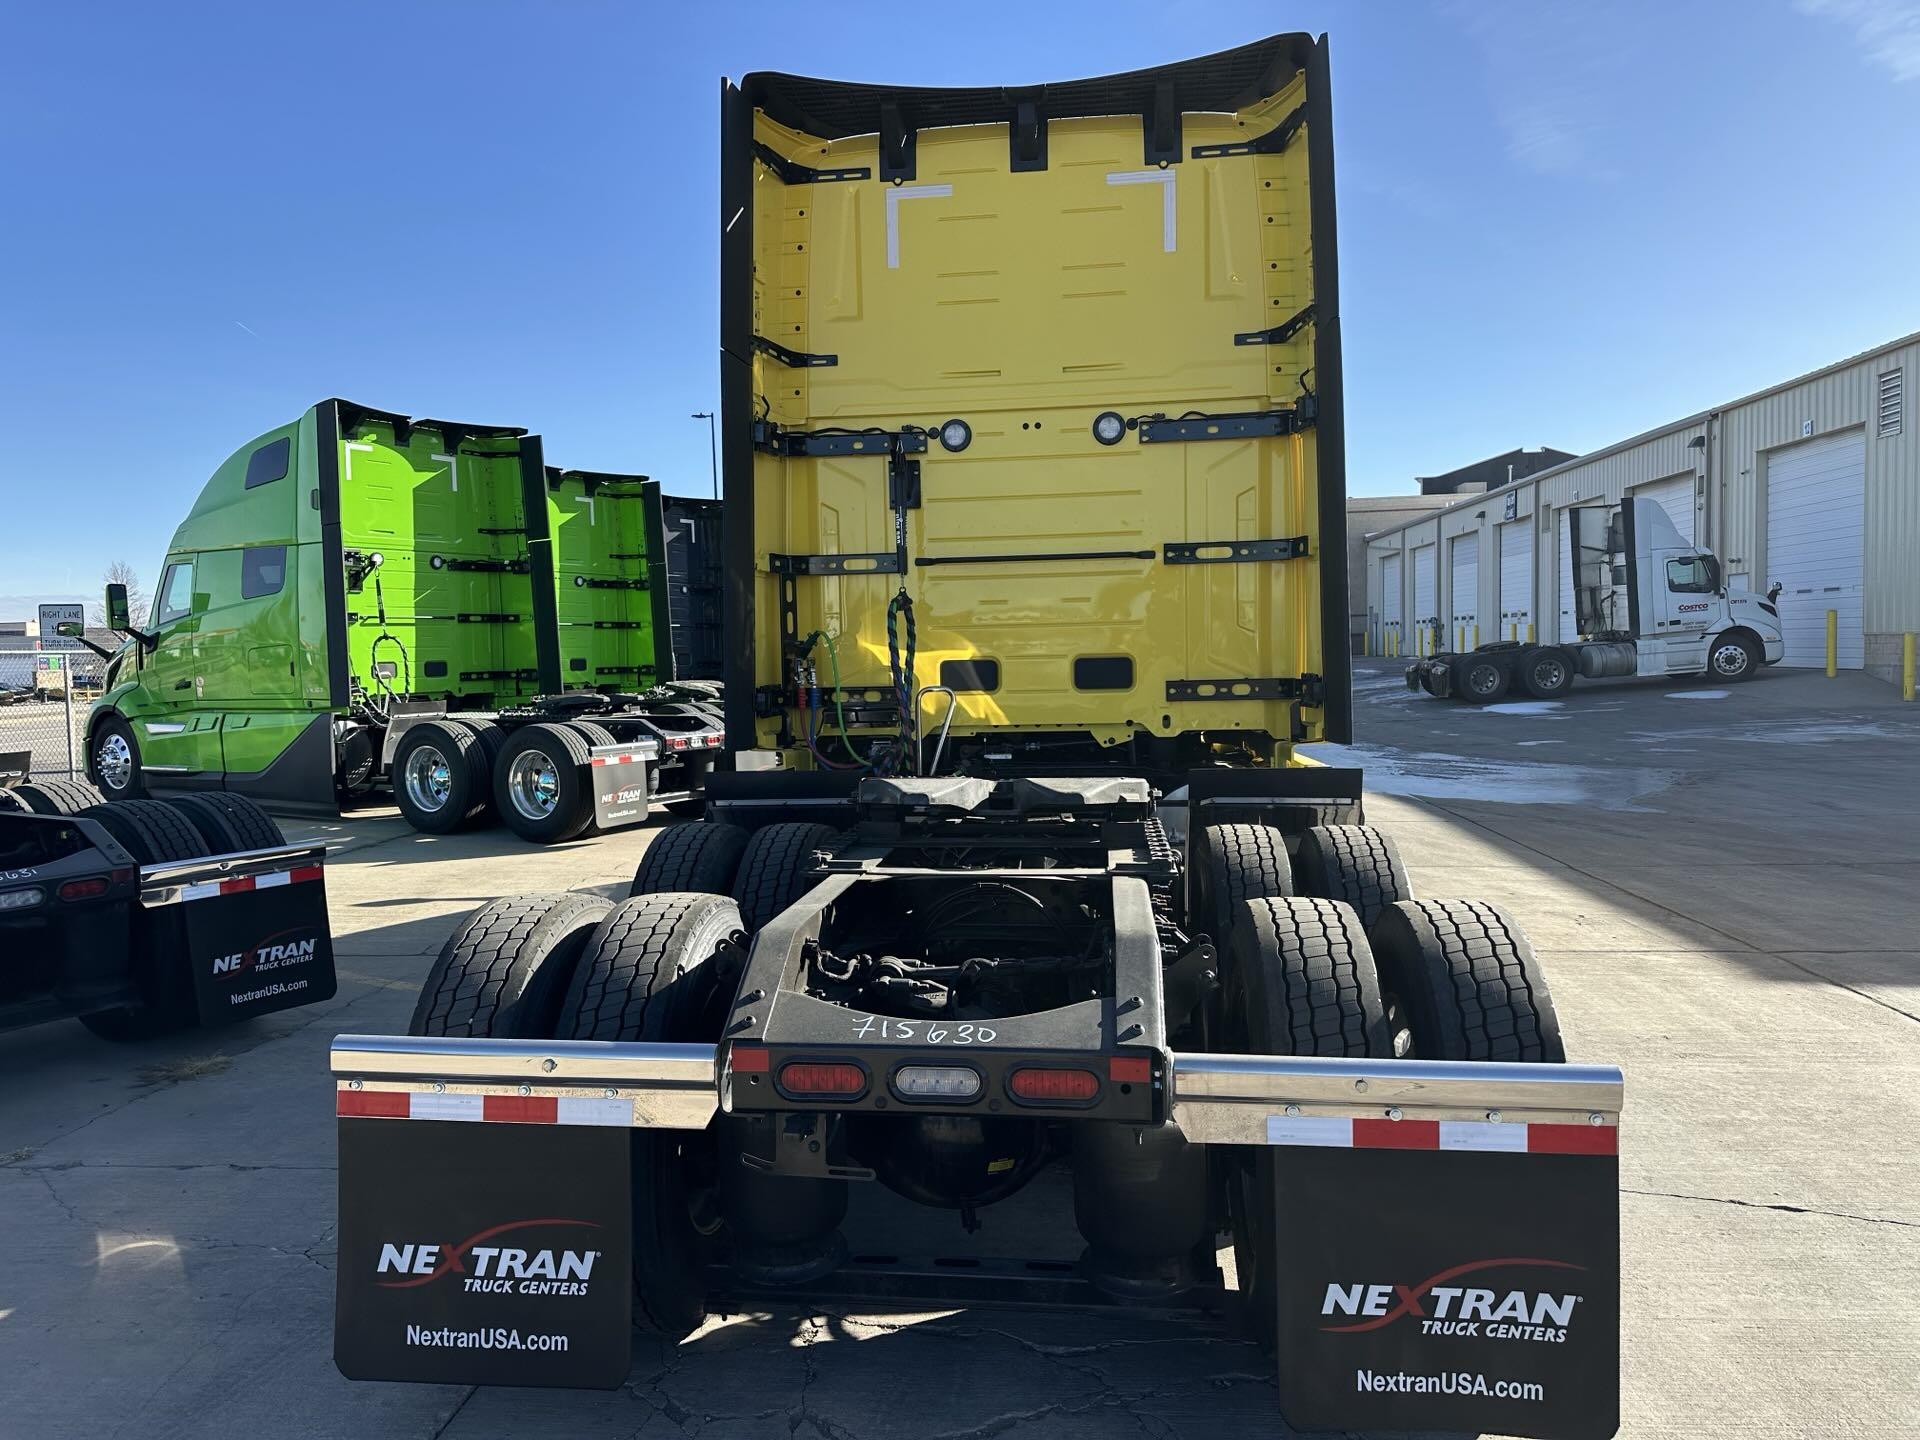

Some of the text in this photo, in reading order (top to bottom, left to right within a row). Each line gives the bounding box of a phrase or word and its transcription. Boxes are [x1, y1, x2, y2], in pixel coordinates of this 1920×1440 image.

[42, 611, 81, 619] RIGHT LANE
[601, 789, 641, 804] NEXTRAN
[213, 939, 316, 975] NEXTRAN
[255, 953, 314, 973] TRUCK CENTERS
[230, 979, 309, 1005] NextranUSA.com
[376, 1243, 596, 1280] NEXTRAN
[463, 1278, 589, 1296] TRUCK CENTERS
[1321, 1283, 1577, 1327] NEXTRAN
[406, 1324, 569, 1351] NextranUSA.com
[1421, 1320, 1568, 1344] TRUCK CENTERS
[1356, 1369, 1544, 1401] NextranUSA.com
